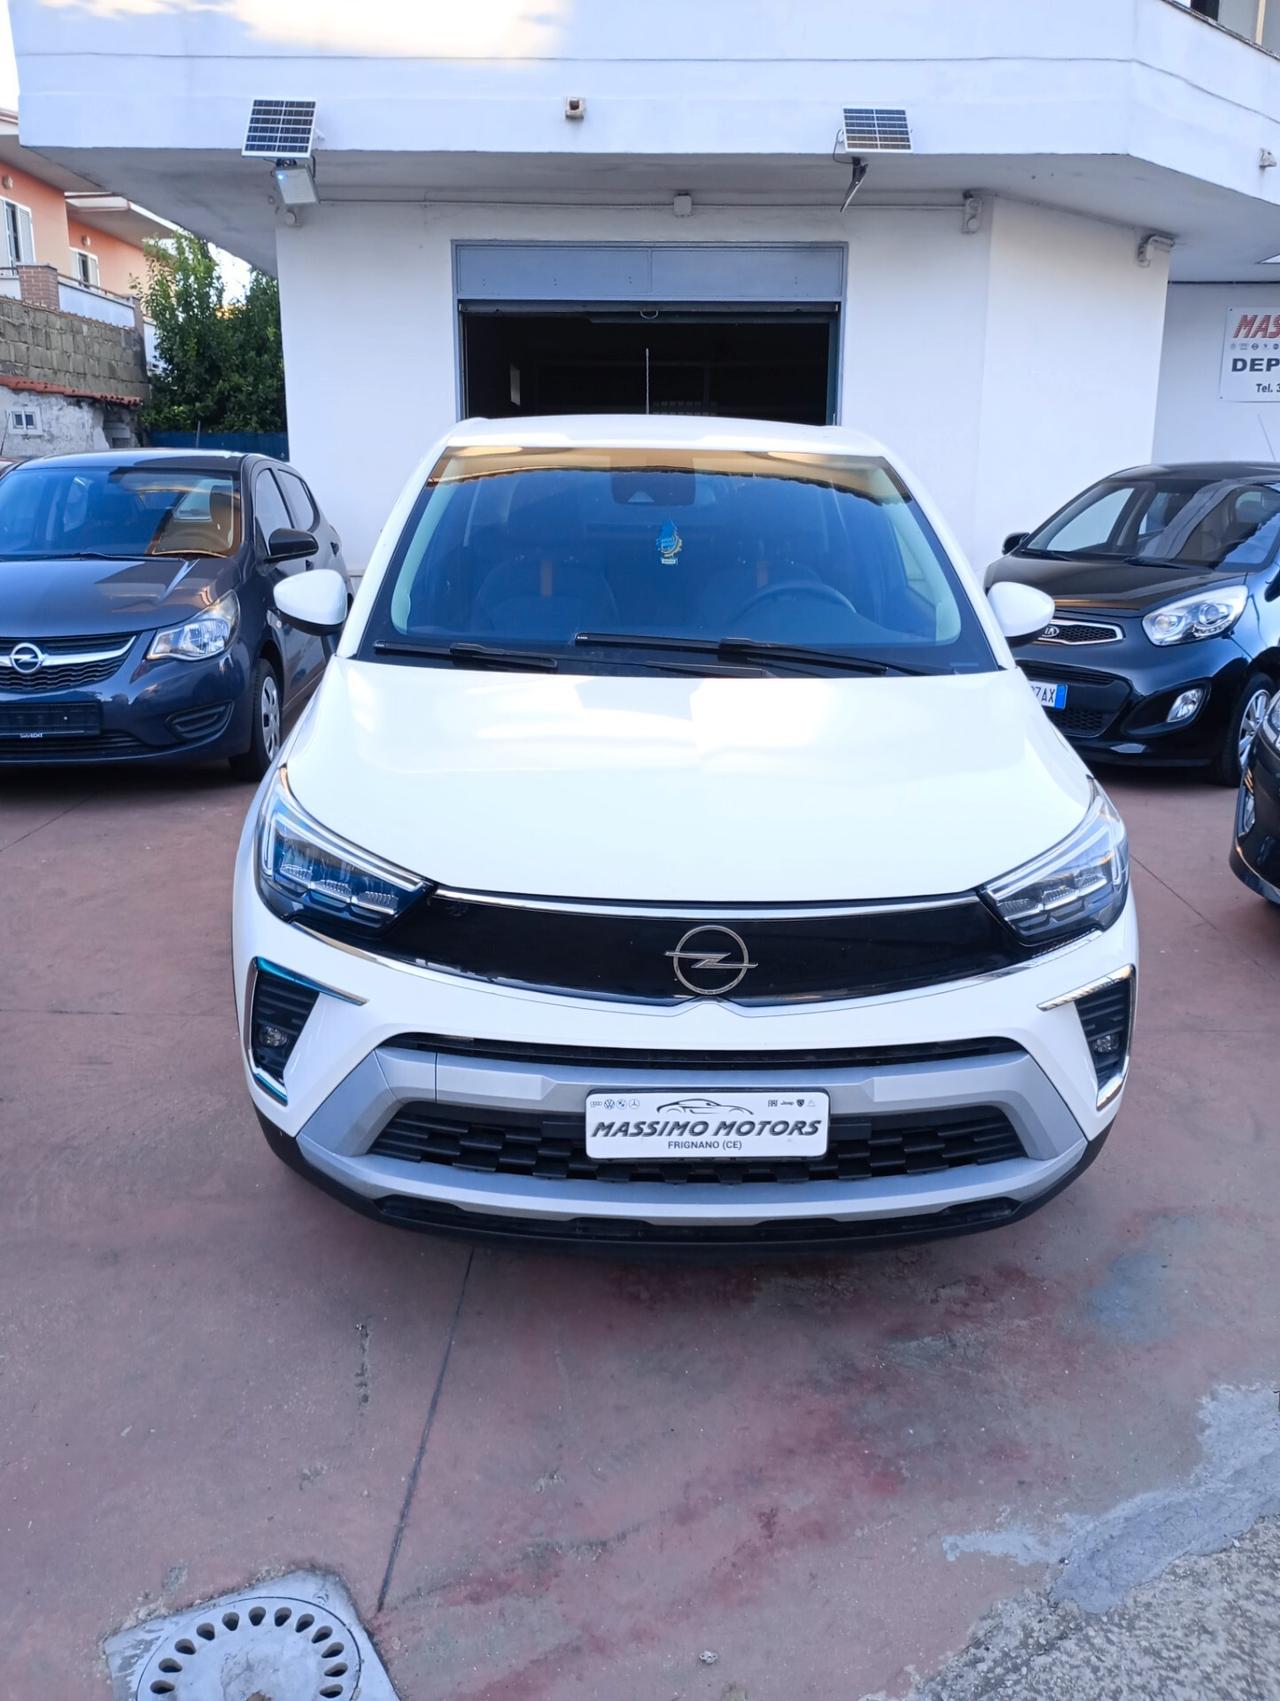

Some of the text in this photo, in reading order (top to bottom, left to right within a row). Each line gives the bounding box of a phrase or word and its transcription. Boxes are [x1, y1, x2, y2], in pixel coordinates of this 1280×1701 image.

[1231, 357, 1280, 372] DEP
[1255, 383, 1273, 393] Tel.
[1031, 686, 1056, 704] 7AX
[591, 1119, 822, 1138] MASSIMO MOTORS
[667, 1140, 743, 1151] FRIGNANO (CE)
